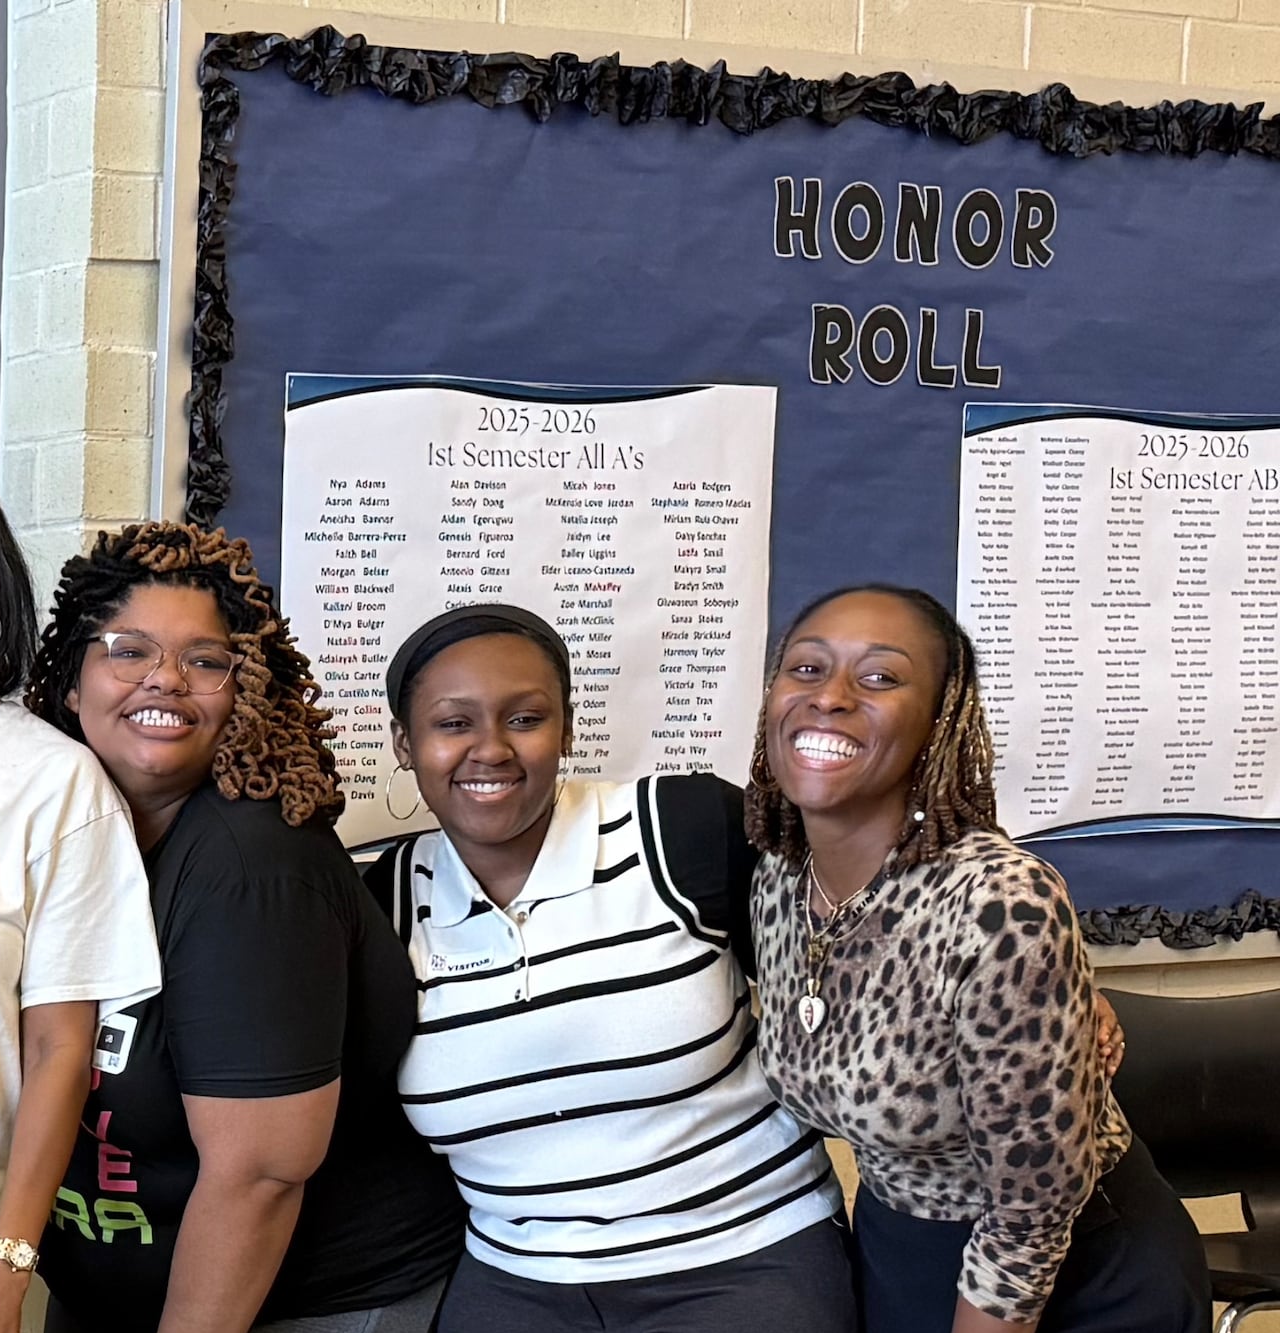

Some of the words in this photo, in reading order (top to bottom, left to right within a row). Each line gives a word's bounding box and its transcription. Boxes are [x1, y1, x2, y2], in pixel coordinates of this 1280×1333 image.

[774, 176, 1057, 270] HONOR
[809, 303, 1002, 389] ROLL
[477, 406, 596, 436] 2025-2026
[1137, 434, 1250, 461] 2025-2026
[462, 441, 572, 468] Semester
[576, 442, 605, 470] All
[611, 444, 645, 470] A's
[1140, 466, 1244, 491] Semester
[330, 479, 347, 491] Nya
[355, 479, 386, 489] Adams
[563, 481, 588, 490] Micah
[594, 481, 616, 490] Jones
[325, 497, 352, 506] Aaron
[359, 497, 390, 506] Adams
[597, 532, 611, 542] Lee
[335, 549, 357, 559] Faith
[360, 549, 377, 559] Bell
[446, 549, 480, 559] Bernard
[487, 549, 506, 559] Ford
[321, 567, 355, 578] Morgan
[314, 584, 349, 594] William
[447, 584, 472, 593] Alexis
[479, 584, 503, 593] Grace
[555, 616, 579, 625] Sarah
[589, 633, 612, 642] Miller
[702, 647, 725, 657] Taylor
[659, 664, 682, 673] Grace
[325, 672, 349, 681] Olivia
[354, 672, 380, 681] Carter
[664, 680, 694, 689] Victoria
[664, 712, 697, 722] Amanda
[351, 790, 375, 800] Davis
